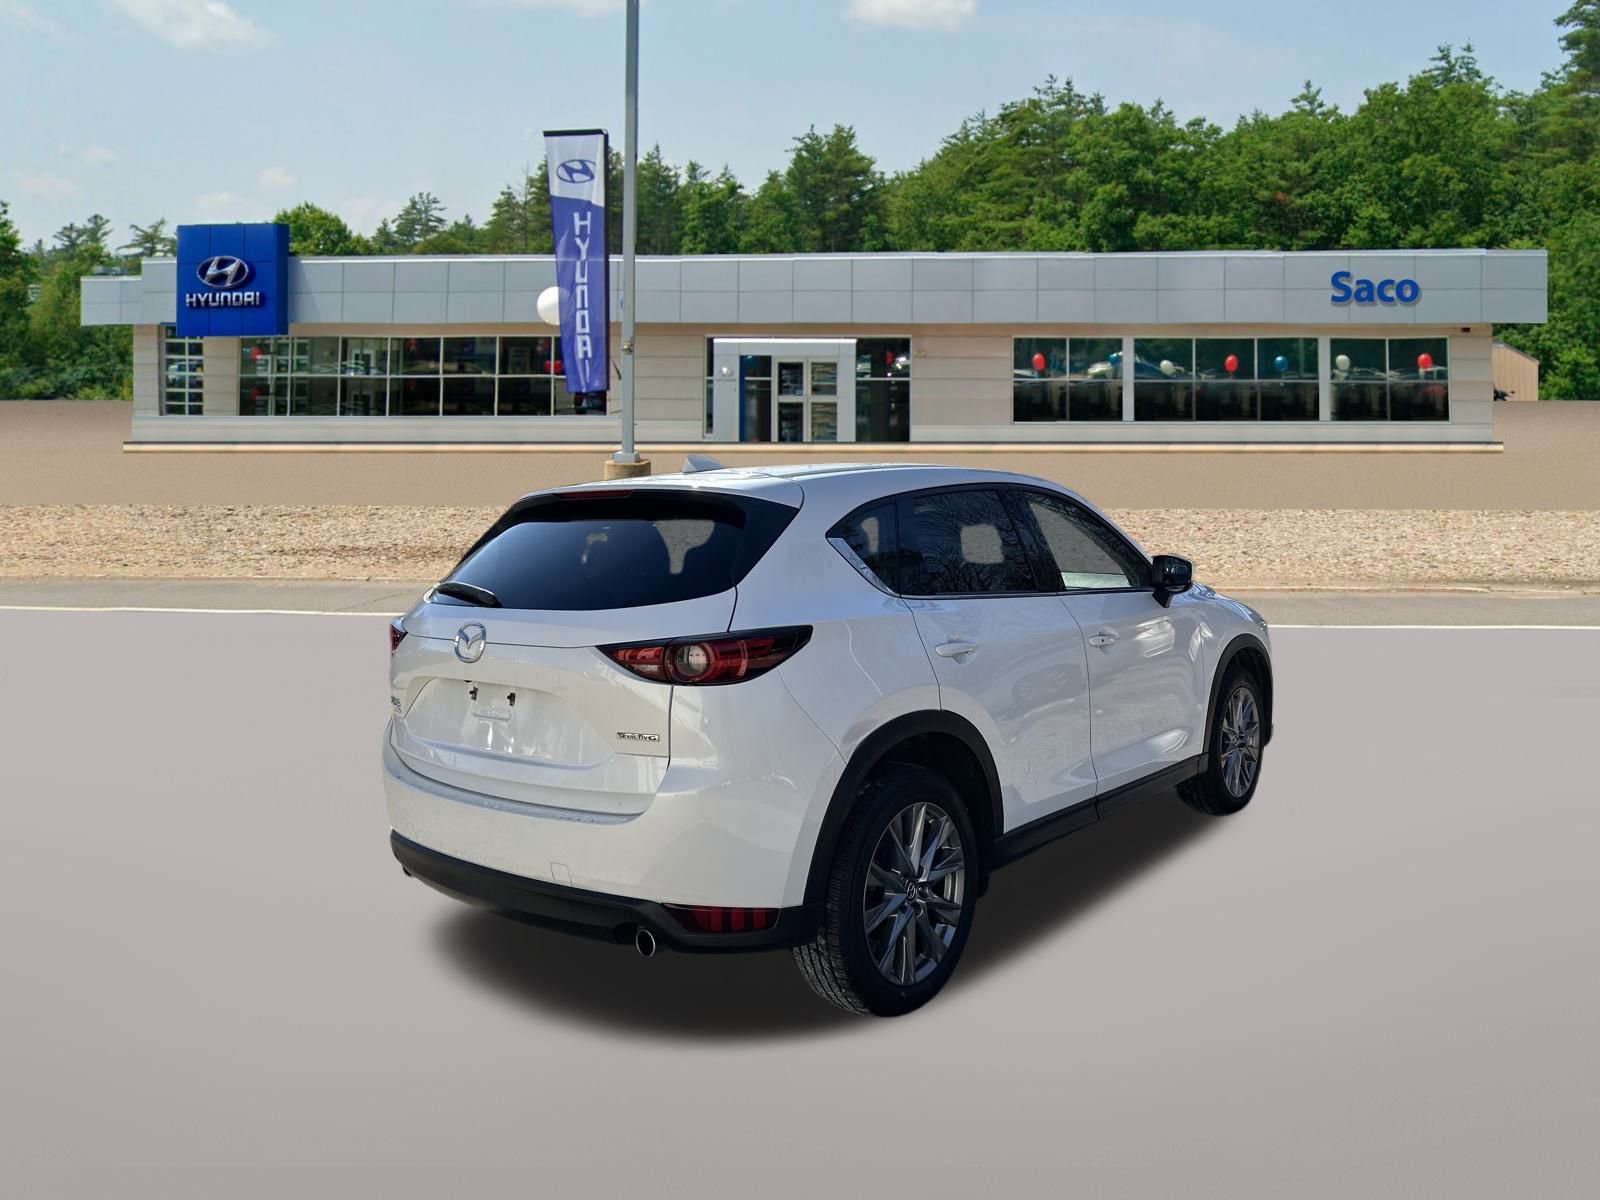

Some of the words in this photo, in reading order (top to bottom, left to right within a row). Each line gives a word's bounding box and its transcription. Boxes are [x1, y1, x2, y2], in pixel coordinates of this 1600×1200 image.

[185, 291, 260, 307] HYUNDAI
[573, 211, 592, 384] HYUNDAI
[1331, 270, 1420, 303] Saco
